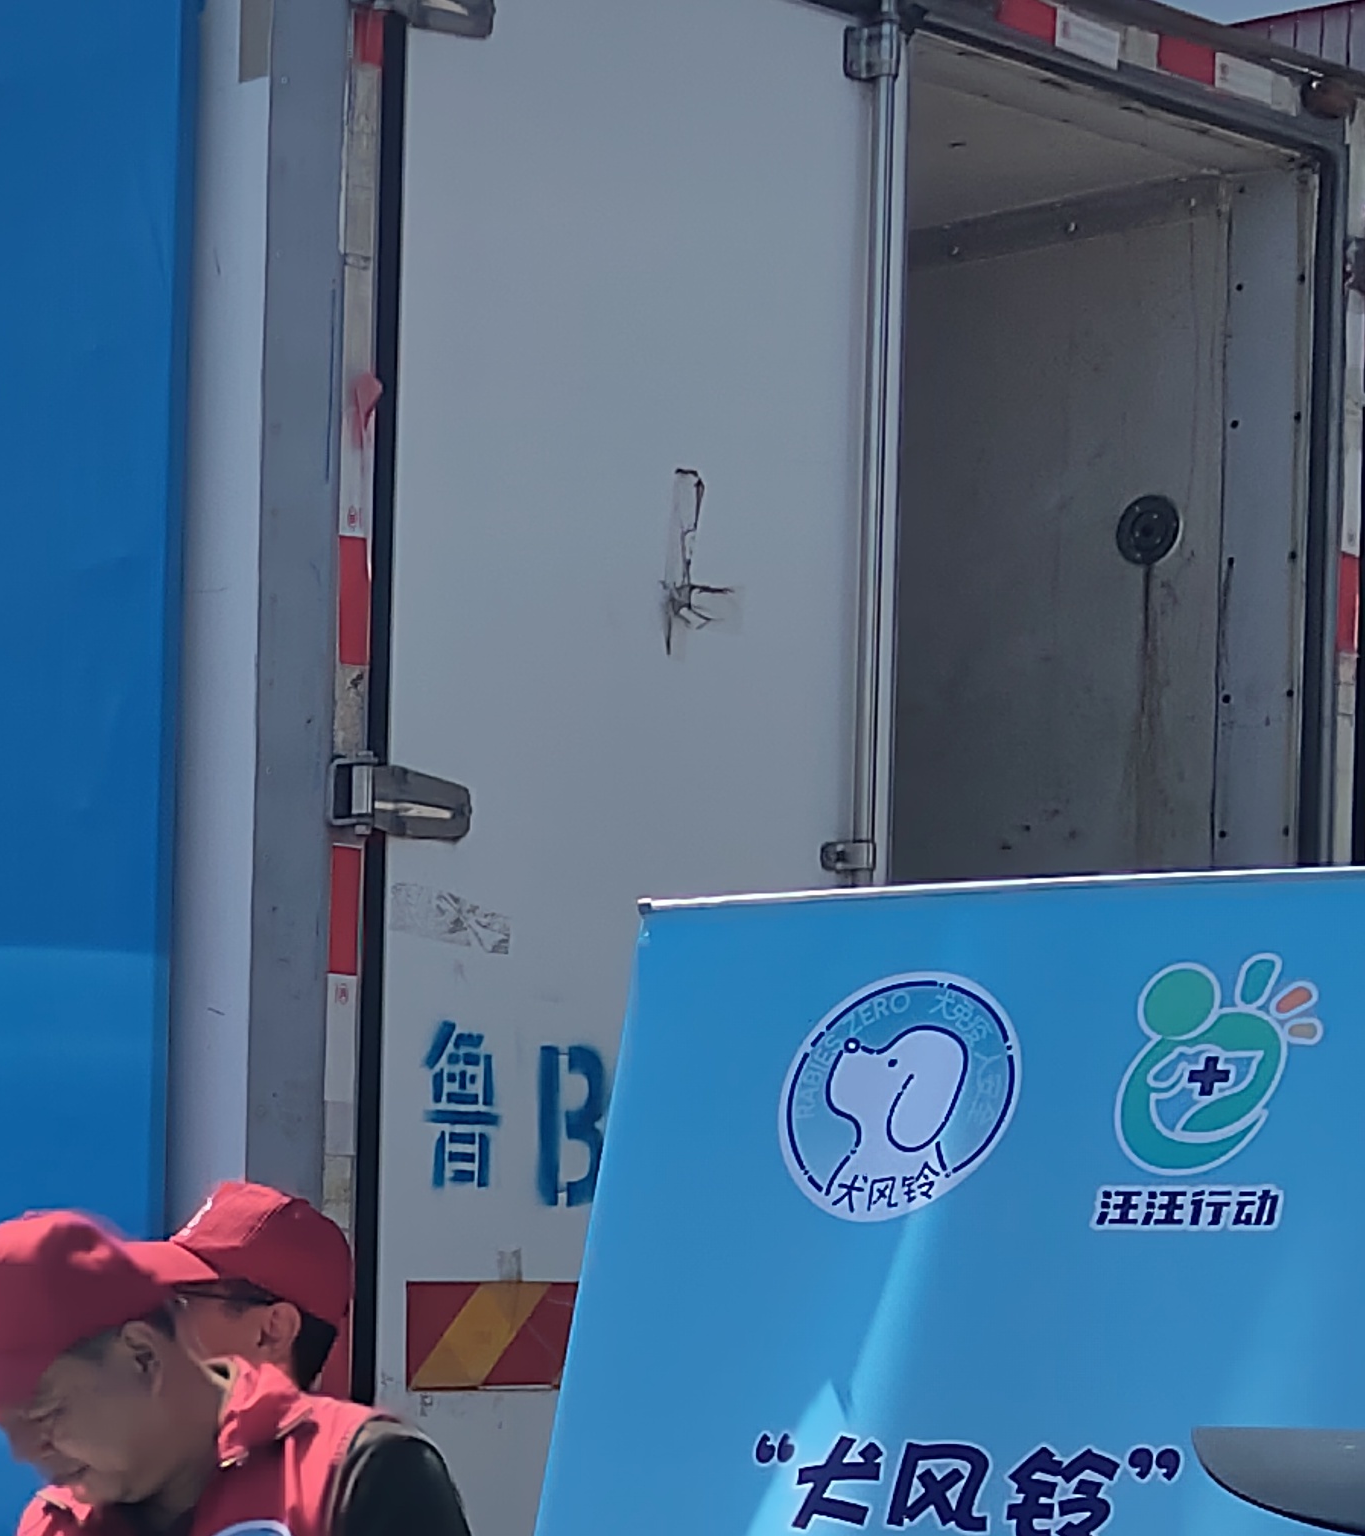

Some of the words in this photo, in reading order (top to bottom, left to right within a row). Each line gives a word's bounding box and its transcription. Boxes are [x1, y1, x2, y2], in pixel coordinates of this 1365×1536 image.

[794, 1033, 845, 1120] RABIES
[840, 990, 911, 1037] ZERO
[831, 1161, 941, 1213] 犬风铃
[1094, 1188, 1280, 1228] 汪汪行动
